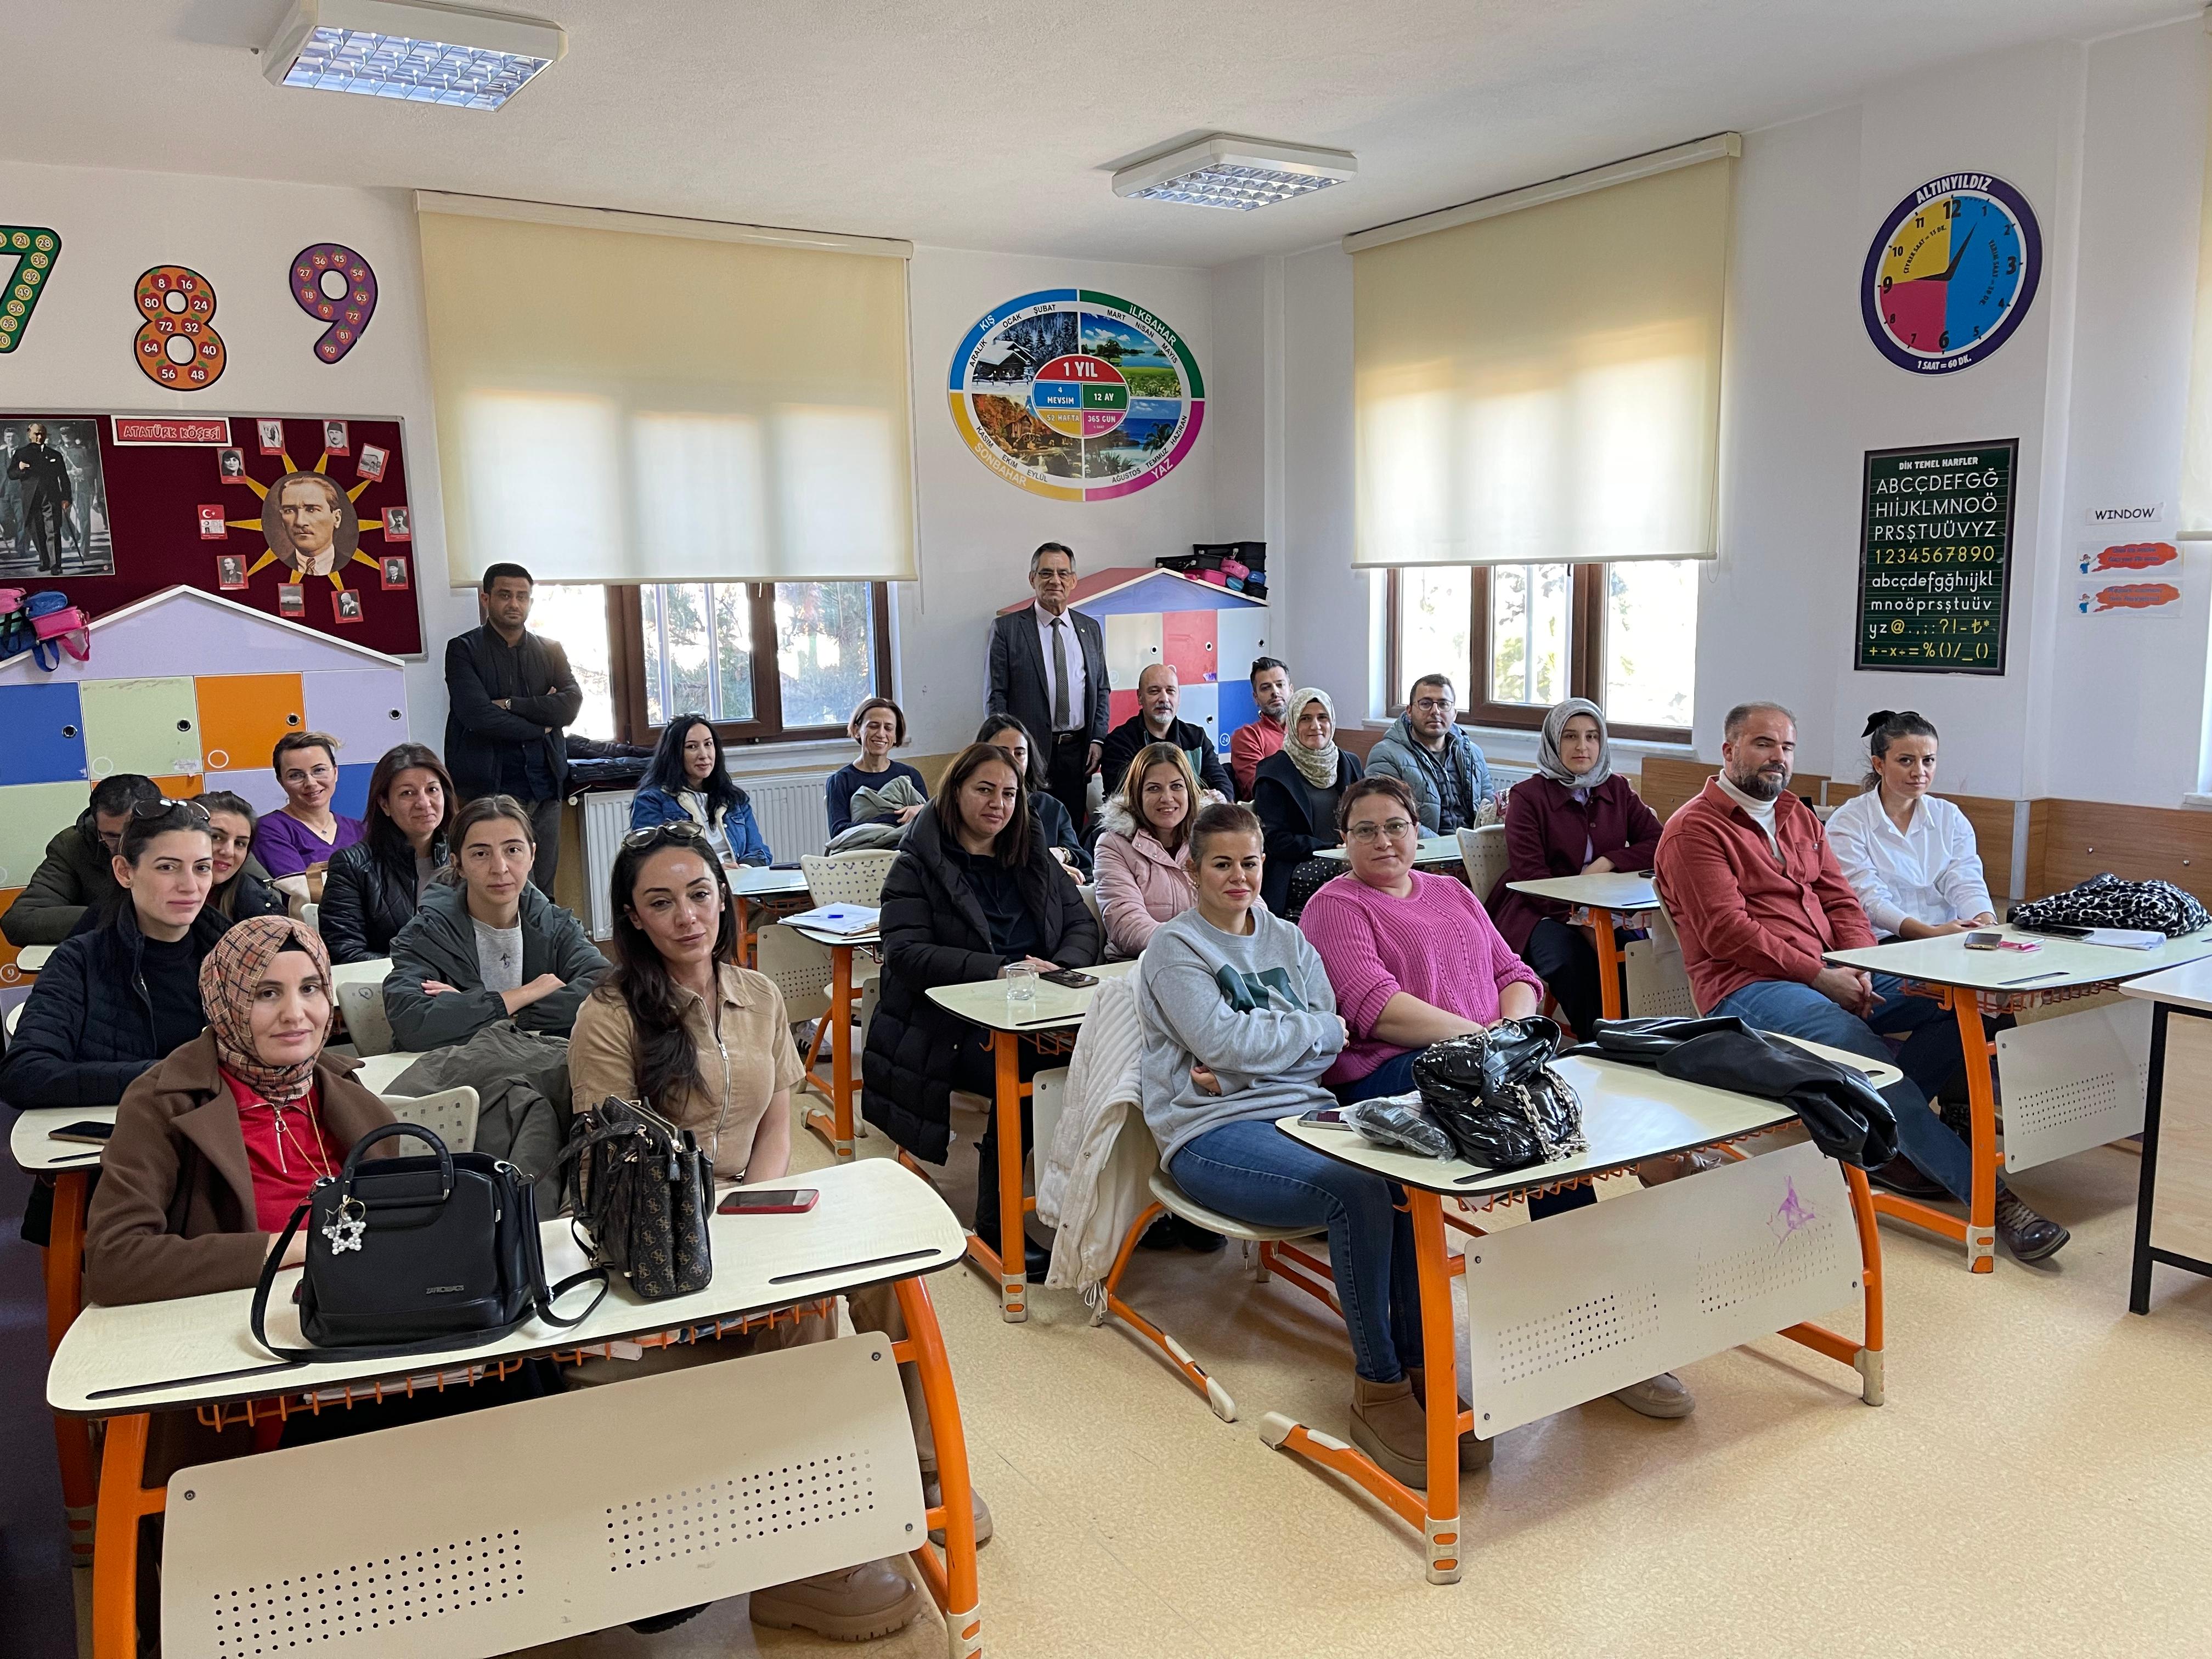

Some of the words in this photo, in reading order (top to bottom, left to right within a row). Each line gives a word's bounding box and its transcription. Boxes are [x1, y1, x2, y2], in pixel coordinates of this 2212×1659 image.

[1916, 174, 1993, 204] ALTINYILDIZ
[1943, 199, 1962, 219] 12
[1982, 205, 1987, 217] 1
[1915, 217, 1925, 228] 11
[2004, 224, 2011, 236] 2
[16, 236, 27, 245] 21
[38, 239, 51, 247] 28
[1893, 246, 1903, 257] 10
[33, 256, 46, 265] 35
[2006, 256, 2017, 275] 3
[25, 272, 37, 281] 42
[158, 279, 166, 288] 8
[181, 280, 193, 290] 16
[1883, 276, 1892, 294] 9
[18, 288, 30, 297] 49
[10, 304, 22, 313] 56
[144, 298, 159, 308] 80
[194, 301, 207, 310] 24
[1998, 298, 2005, 308] 4
[1033, 304, 1056, 315] ŞUBAT
[1107, 309, 1126, 321] MART
[2, 319, 16, 328] 63
[979, 315, 996, 331] KIŞ
[1002, 313, 1022, 328] OCAK
[1890, 313, 1896, 324] 8
[159, 322, 173, 332] 72
[184, 323, 199, 332] 32
[1129, 304, 1177, 346] İLKBAHAR
[1973, 326, 1979, 337] 5
[0, 336, 8, 345] 0
[1911, 334, 1917, 344] 7
[1939, 330, 1950, 349] 6
[144, 343, 159, 353] 64
[202, 346, 217, 355] 40
[969, 338, 988, 368] ARALIK
[1161, 343, 1178, 364] MAYIS
[1064, 362, 1069, 376] 1
[1075, 362, 1098, 377] YIL
[1917, 360, 1922, 369] 1
[1922, 362, 1940, 370] SAAT
[161, 369, 176, 379] 56
[190, 370, 205, 380] 48
[1094, 393, 1102, 401] 12
[123, 424, 177, 438] ATATÜRK
[180, 425, 221, 441] KÖŞESİ
[976, 426, 994, 448] KASIM
[1146, 447, 1169, 468] TEMMUZ
[974, 443, 1026, 486] SONBAHAR
[1151, 458, 1173, 479] YAZ
[1899, 461, 1912, 470] DİK
[1915, 460, 1940, 469] TEMEL
[1942, 457, 1978, 467] HARFLER
[1112, 467, 1141, 483] AĞUSTOS
[2095, 508, 2154, 520] WINDOW
